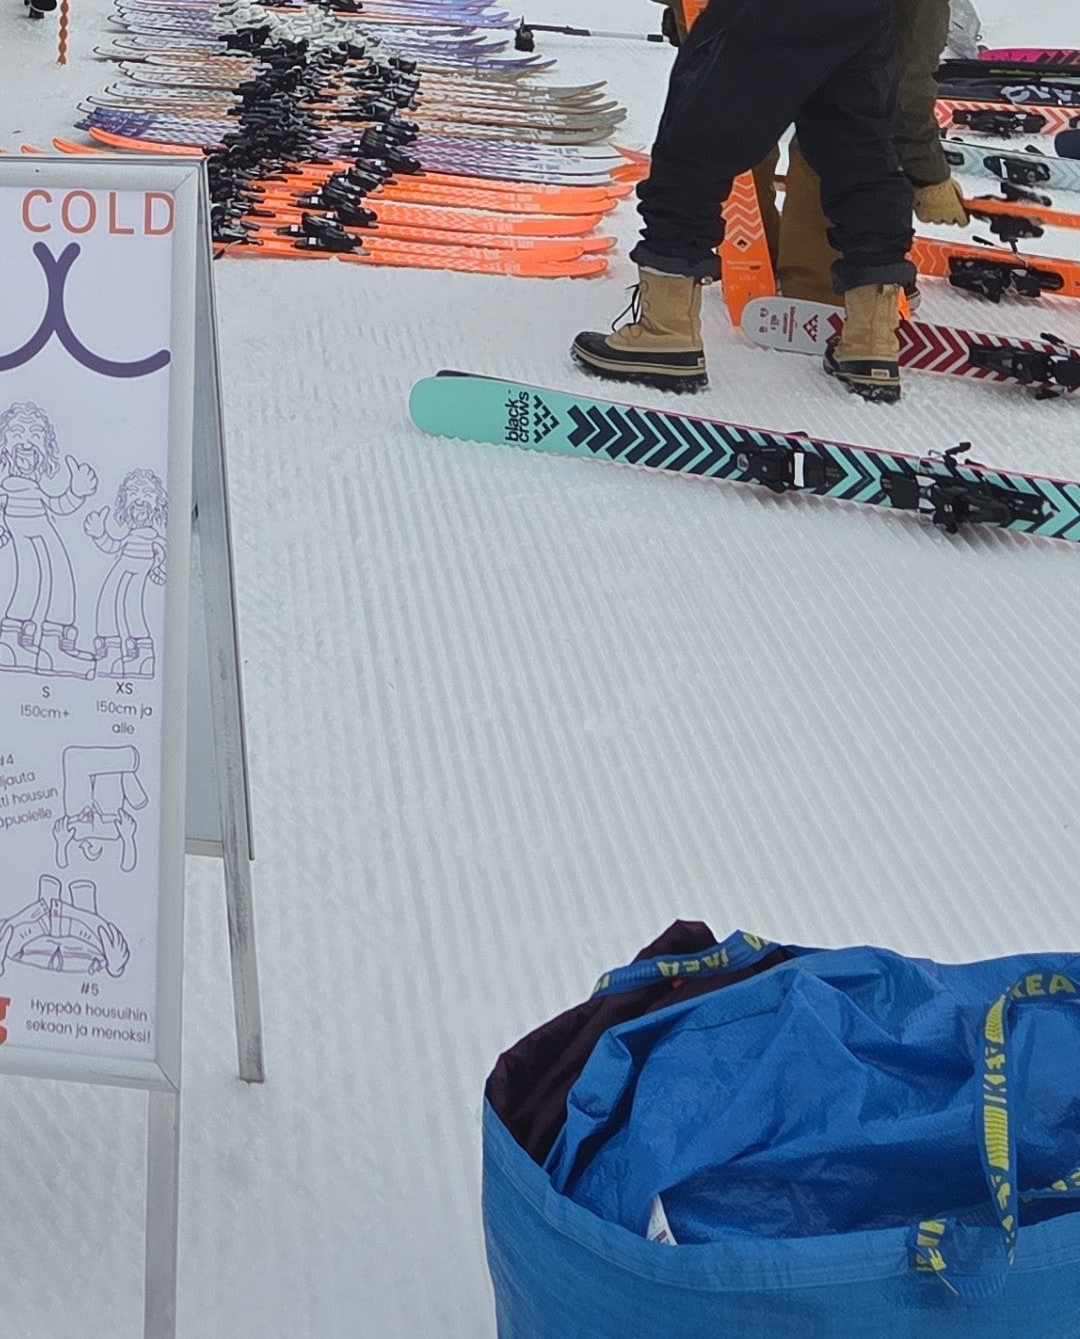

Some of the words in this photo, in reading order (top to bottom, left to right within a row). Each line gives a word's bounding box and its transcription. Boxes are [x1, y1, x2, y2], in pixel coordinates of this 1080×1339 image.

[21, 188, 174, 236] COLD
[505, 398, 519, 441] black
[519, 391, 529, 443] crows
[41, 685, 51, 699] S
[115, 681, 134, 695] XS
[20, 704, 70, 719] 150cm+
[96, 700, 137, 715] 150cm
[140, 704, 153, 719] ja
[111, 721, 135, 735] alle
[11, 787, 59, 806] housun
[80, 982, 99, 997] #5
[75, 1022, 88, 1039] ja
